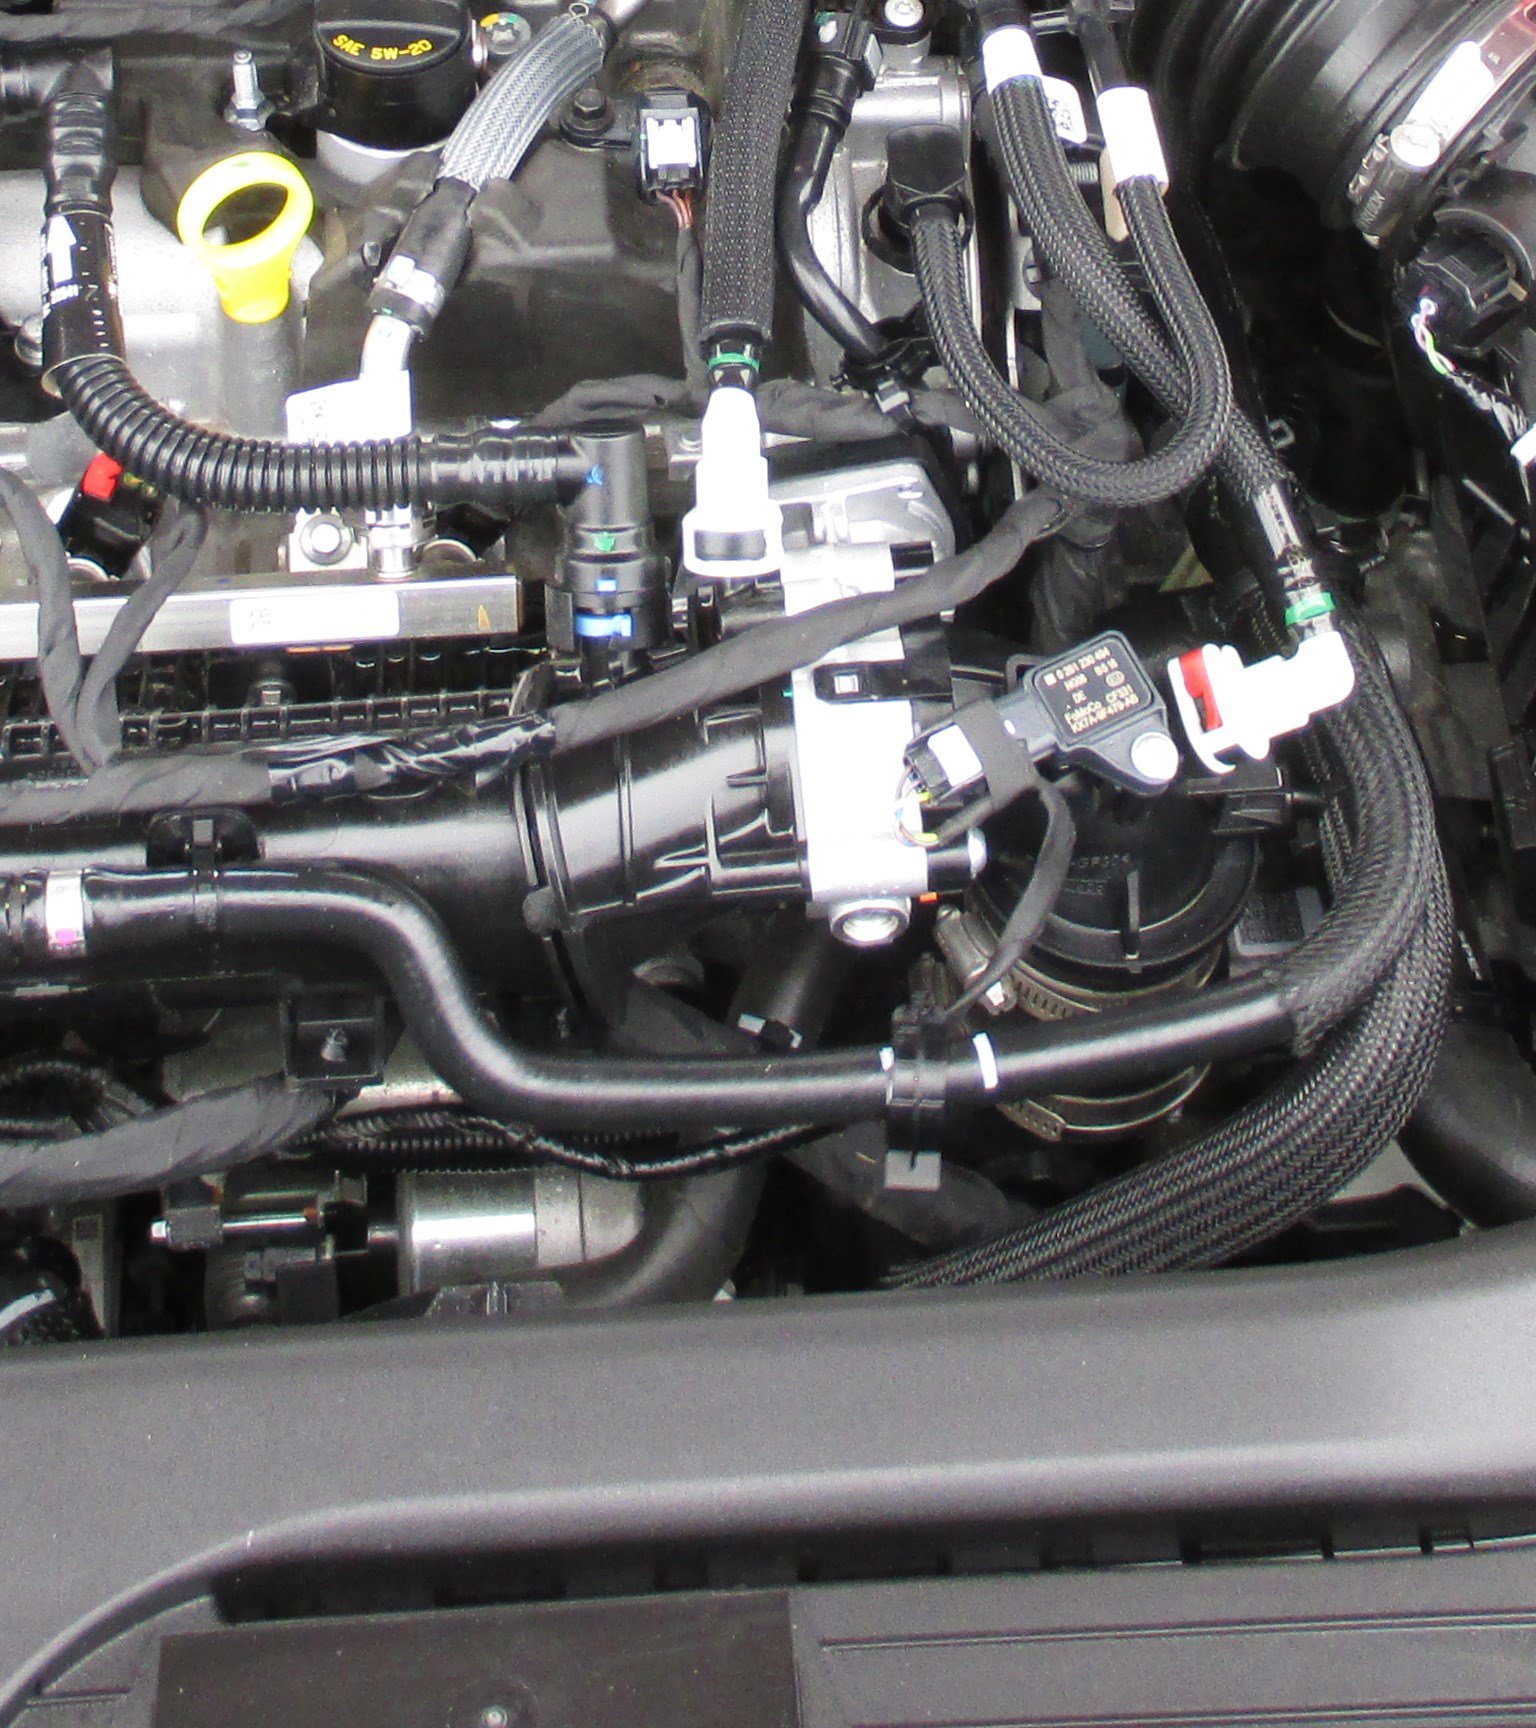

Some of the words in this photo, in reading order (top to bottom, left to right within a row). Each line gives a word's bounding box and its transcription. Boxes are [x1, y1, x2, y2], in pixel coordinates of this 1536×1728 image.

[331, 34, 366, 56] SAE
[370, 39, 434, 61] 5W-20
[1064, 701, 1102, 722] FoMoCo
